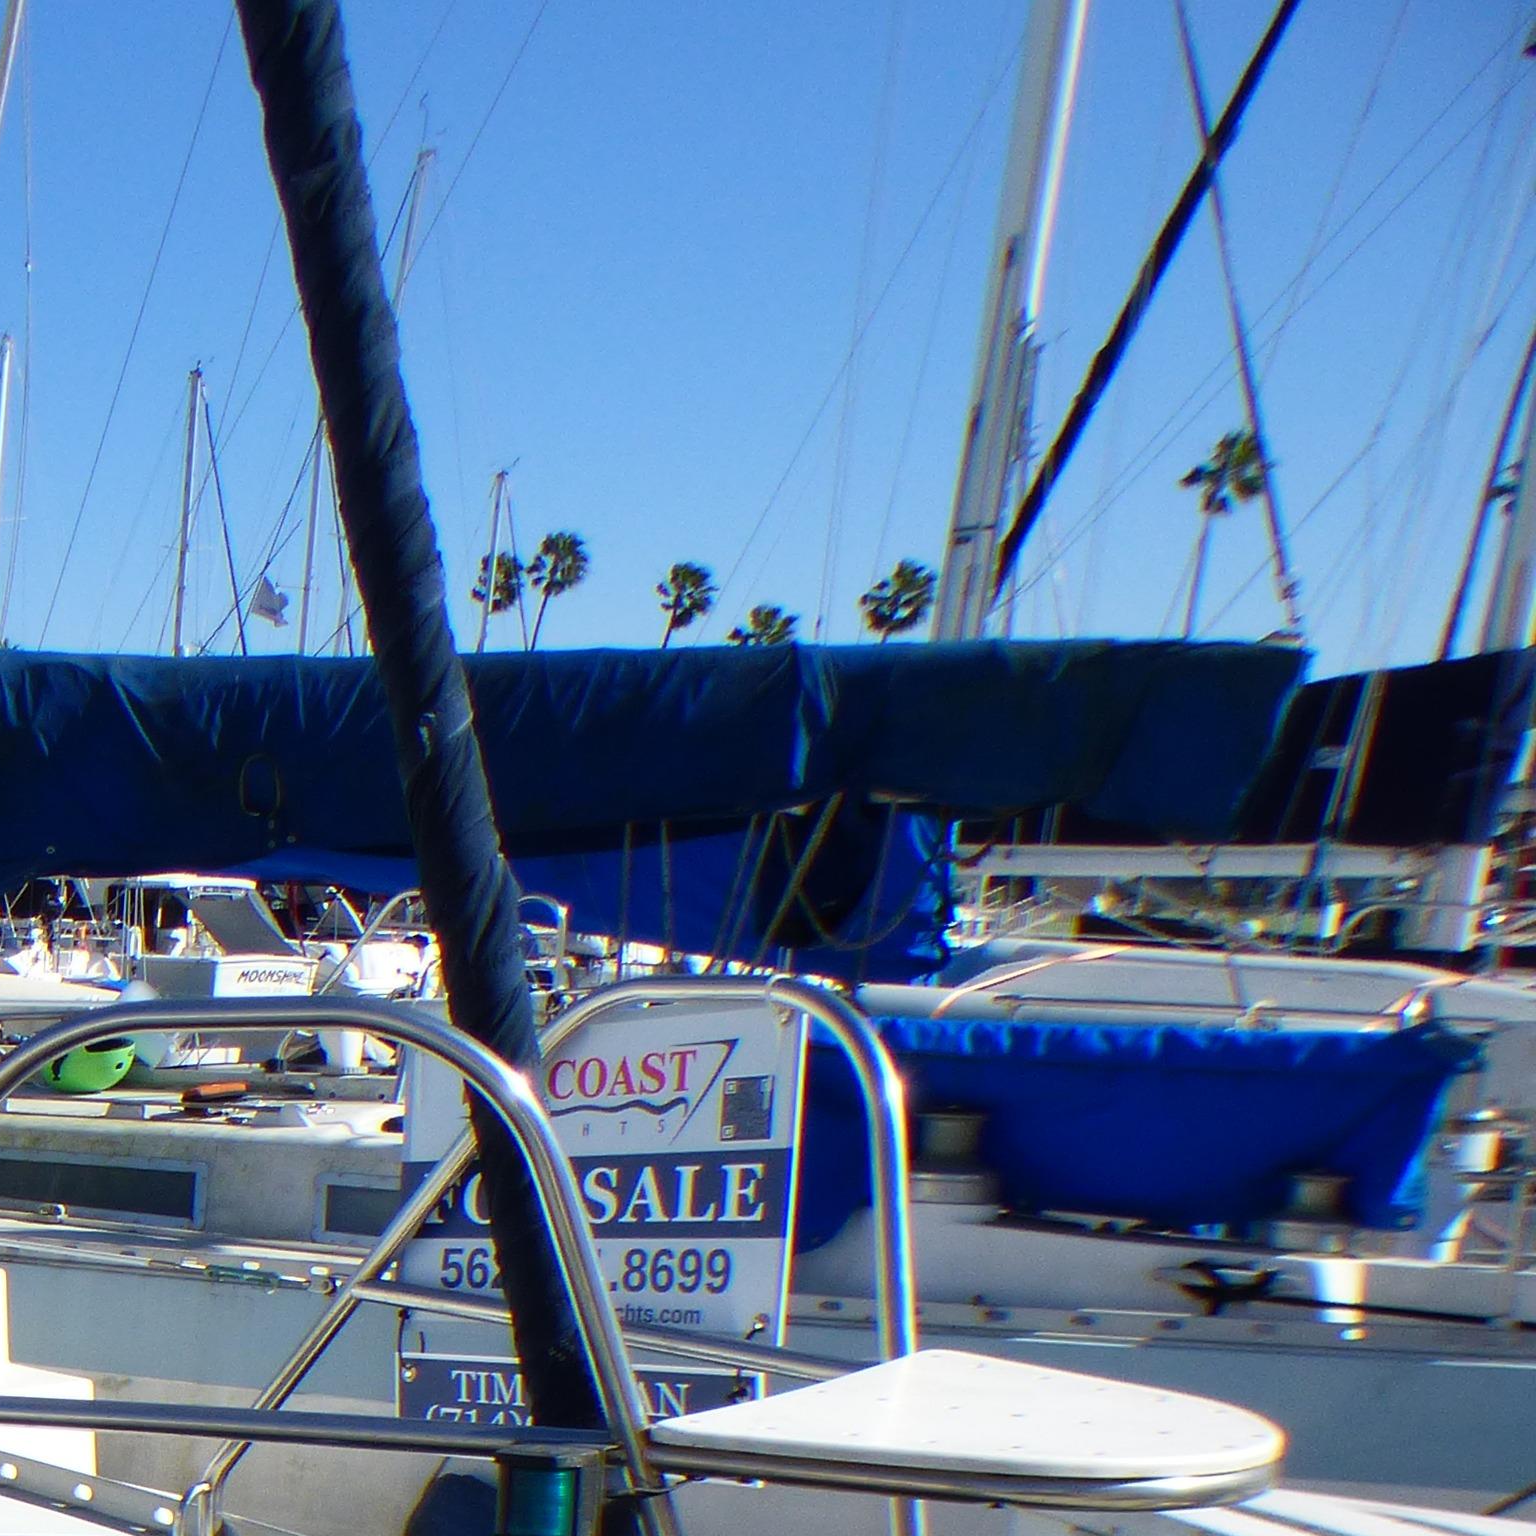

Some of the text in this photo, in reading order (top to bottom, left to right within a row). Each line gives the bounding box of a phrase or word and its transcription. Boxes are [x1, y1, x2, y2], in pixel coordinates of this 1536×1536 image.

[548, 1049, 696, 1100] COAST
[583, 1163, 766, 1225] SALE
[451, 1369, 526, 1407] TIM
